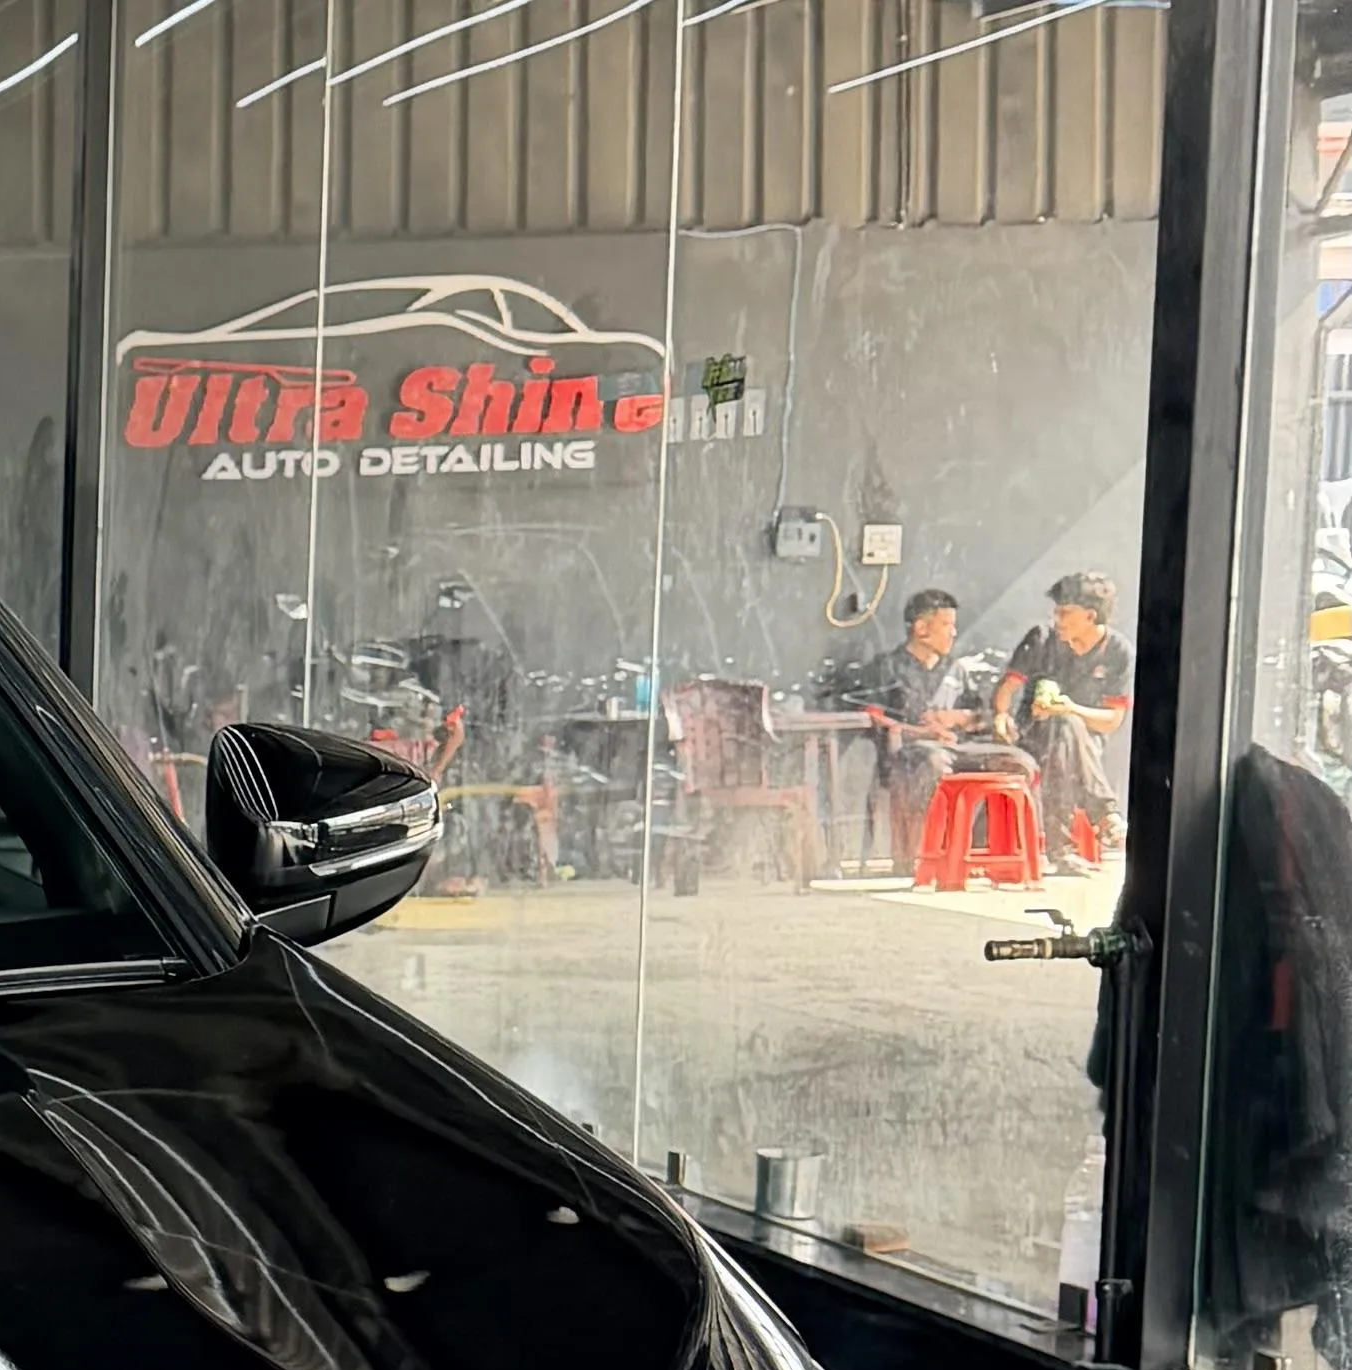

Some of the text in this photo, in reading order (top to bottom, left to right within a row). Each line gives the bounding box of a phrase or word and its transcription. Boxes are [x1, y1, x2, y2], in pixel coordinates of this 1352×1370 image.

[124, 360, 369, 449] Ultra
[201, 440, 595, 481] AUTO DETAILING
